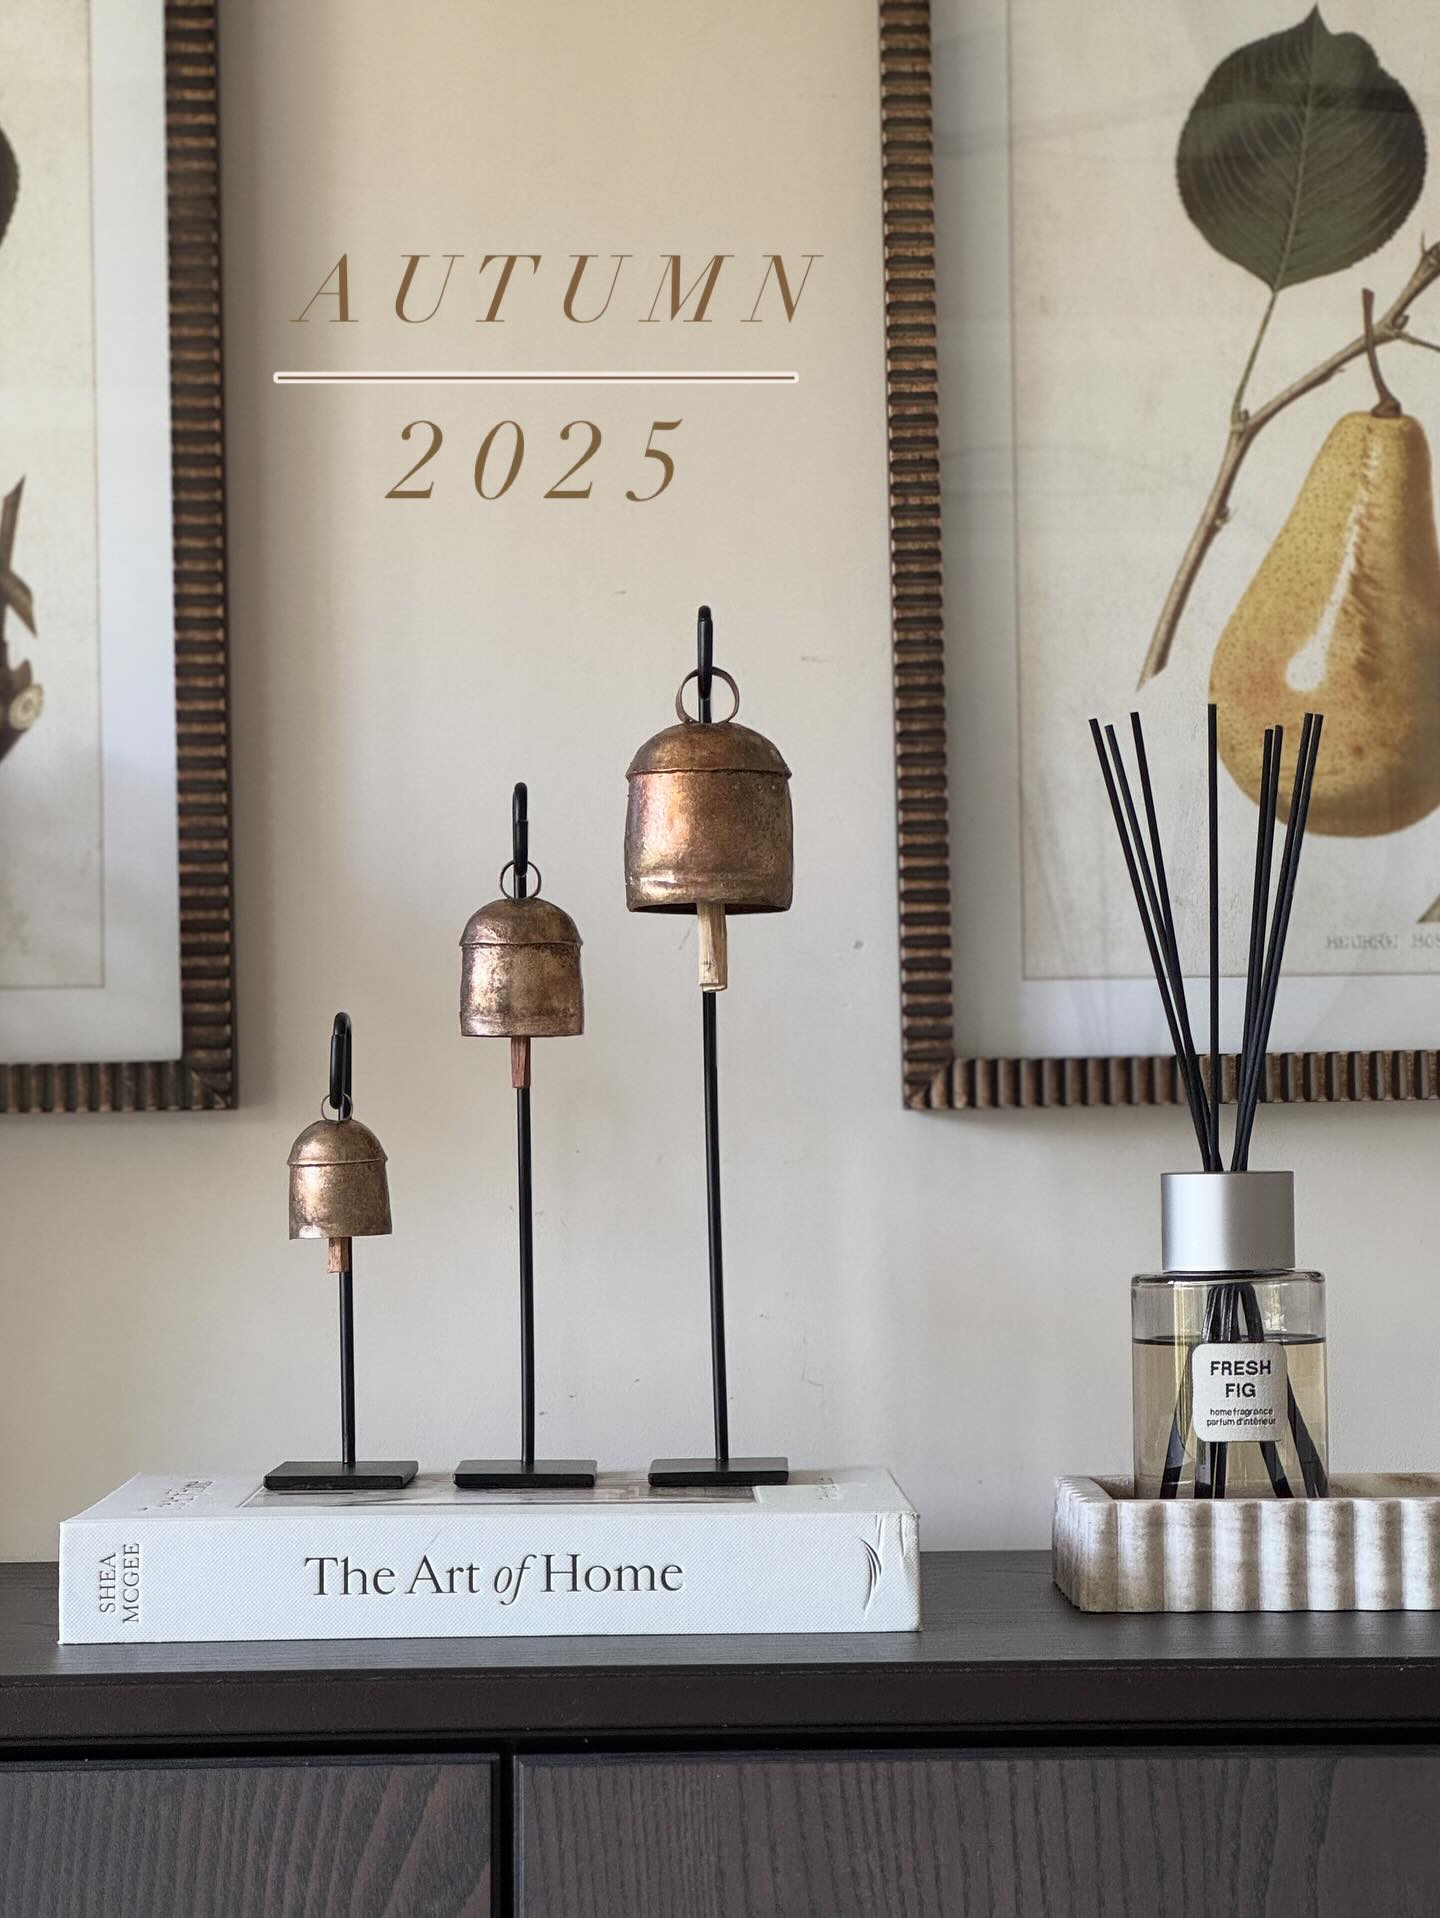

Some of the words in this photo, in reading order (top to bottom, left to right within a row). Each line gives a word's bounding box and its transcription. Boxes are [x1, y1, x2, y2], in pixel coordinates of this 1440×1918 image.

[1210, 1359, 1271, 1376] FRESH
[1225, 1382, 1256, 1398] FIG
[1210, 1407, 1232, 1416] home
[1233, 1407, 1274, 1418] fragrance
[1206, 1417, 1236, 1427] parfum
[99, 1552, 117, 1613] SHEA
[122, 1542, 140, 1624] MCGEE
[305, 1555, 396, 1596] The
[404, 1554, 481, 1595] Art
[493, 1553, 537, 1606] of
[540, 1553, 684, 1593] Home
